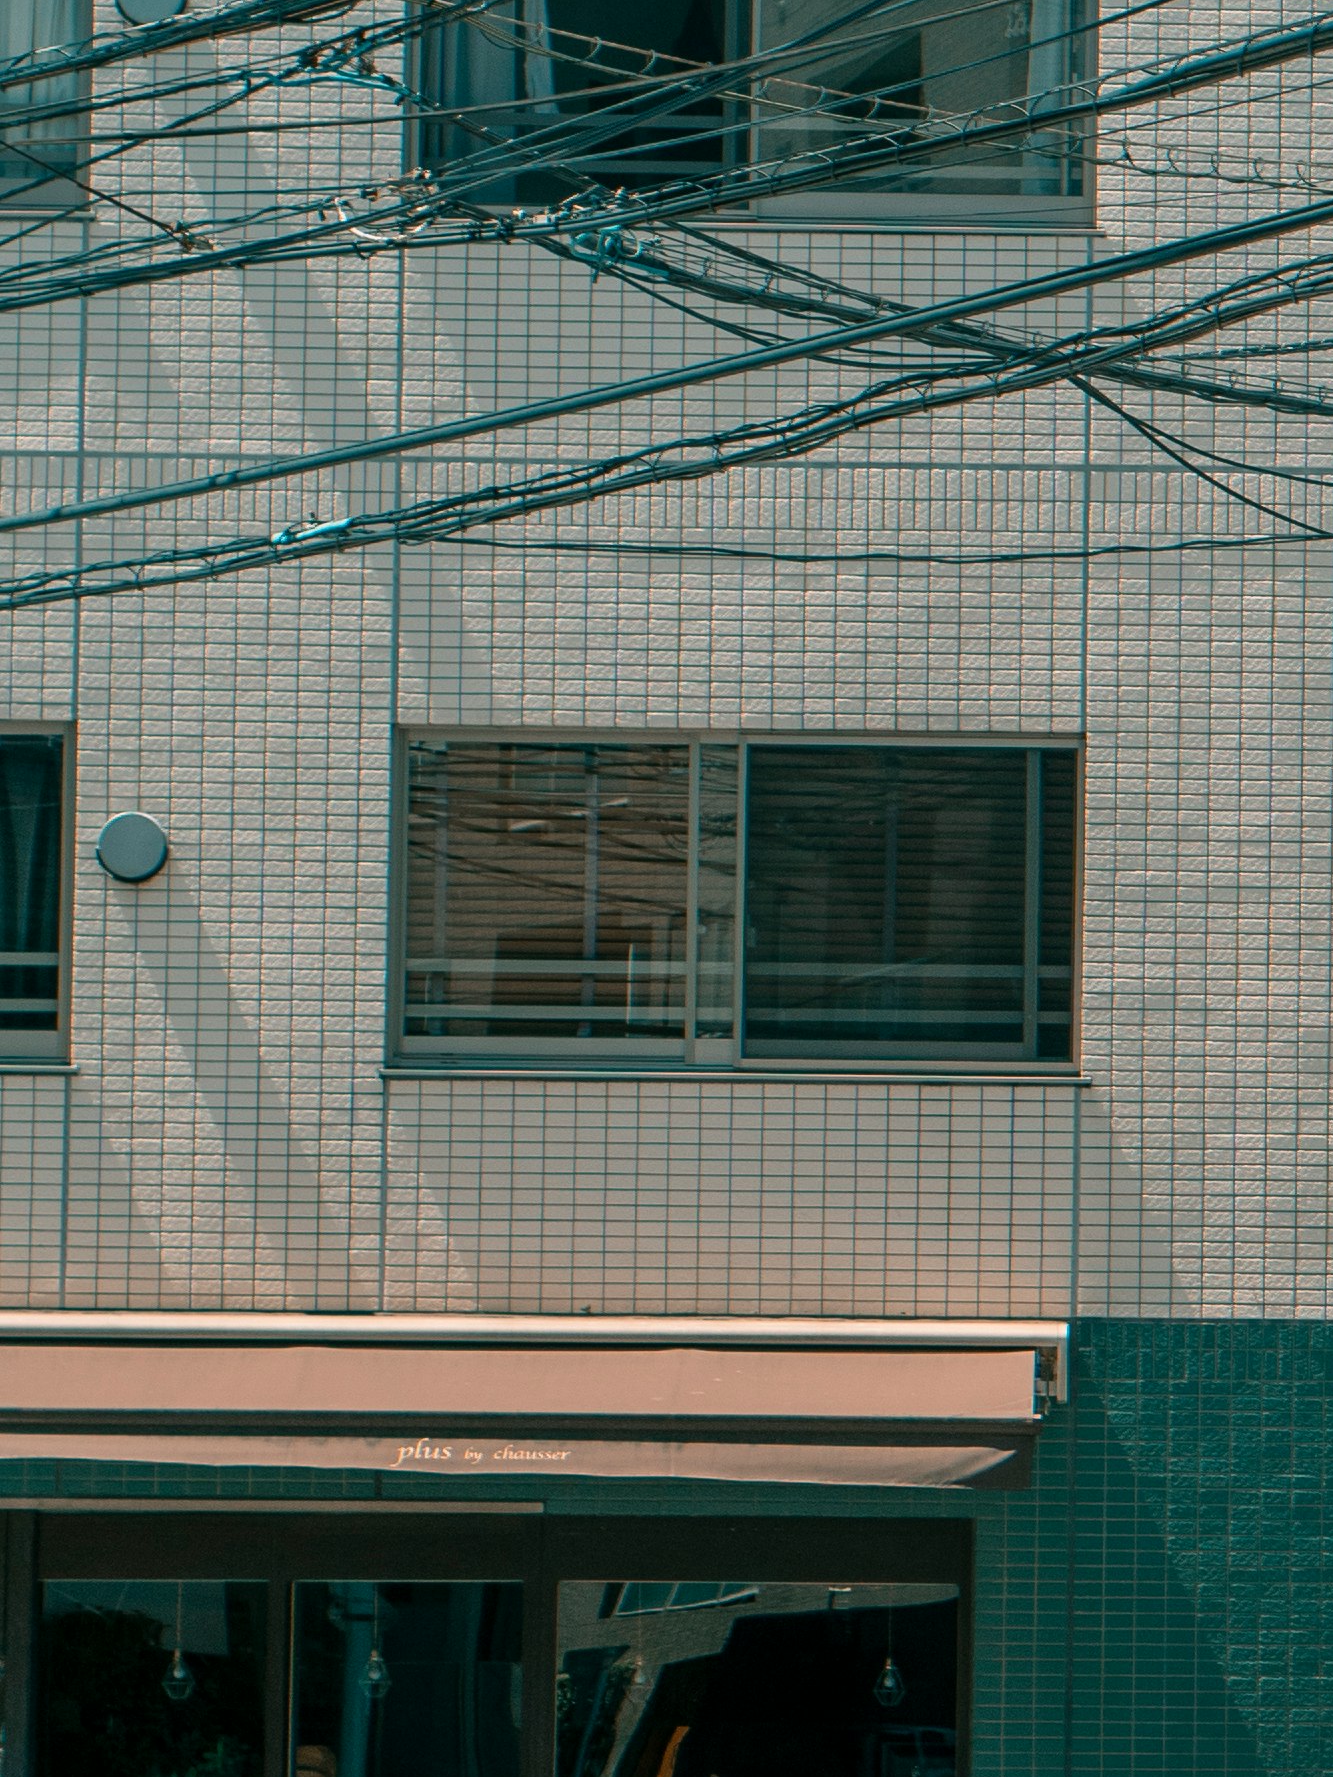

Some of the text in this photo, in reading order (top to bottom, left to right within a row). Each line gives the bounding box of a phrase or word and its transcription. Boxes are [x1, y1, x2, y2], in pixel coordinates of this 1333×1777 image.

[390, 1437, 572, 1468] plus by chausser
